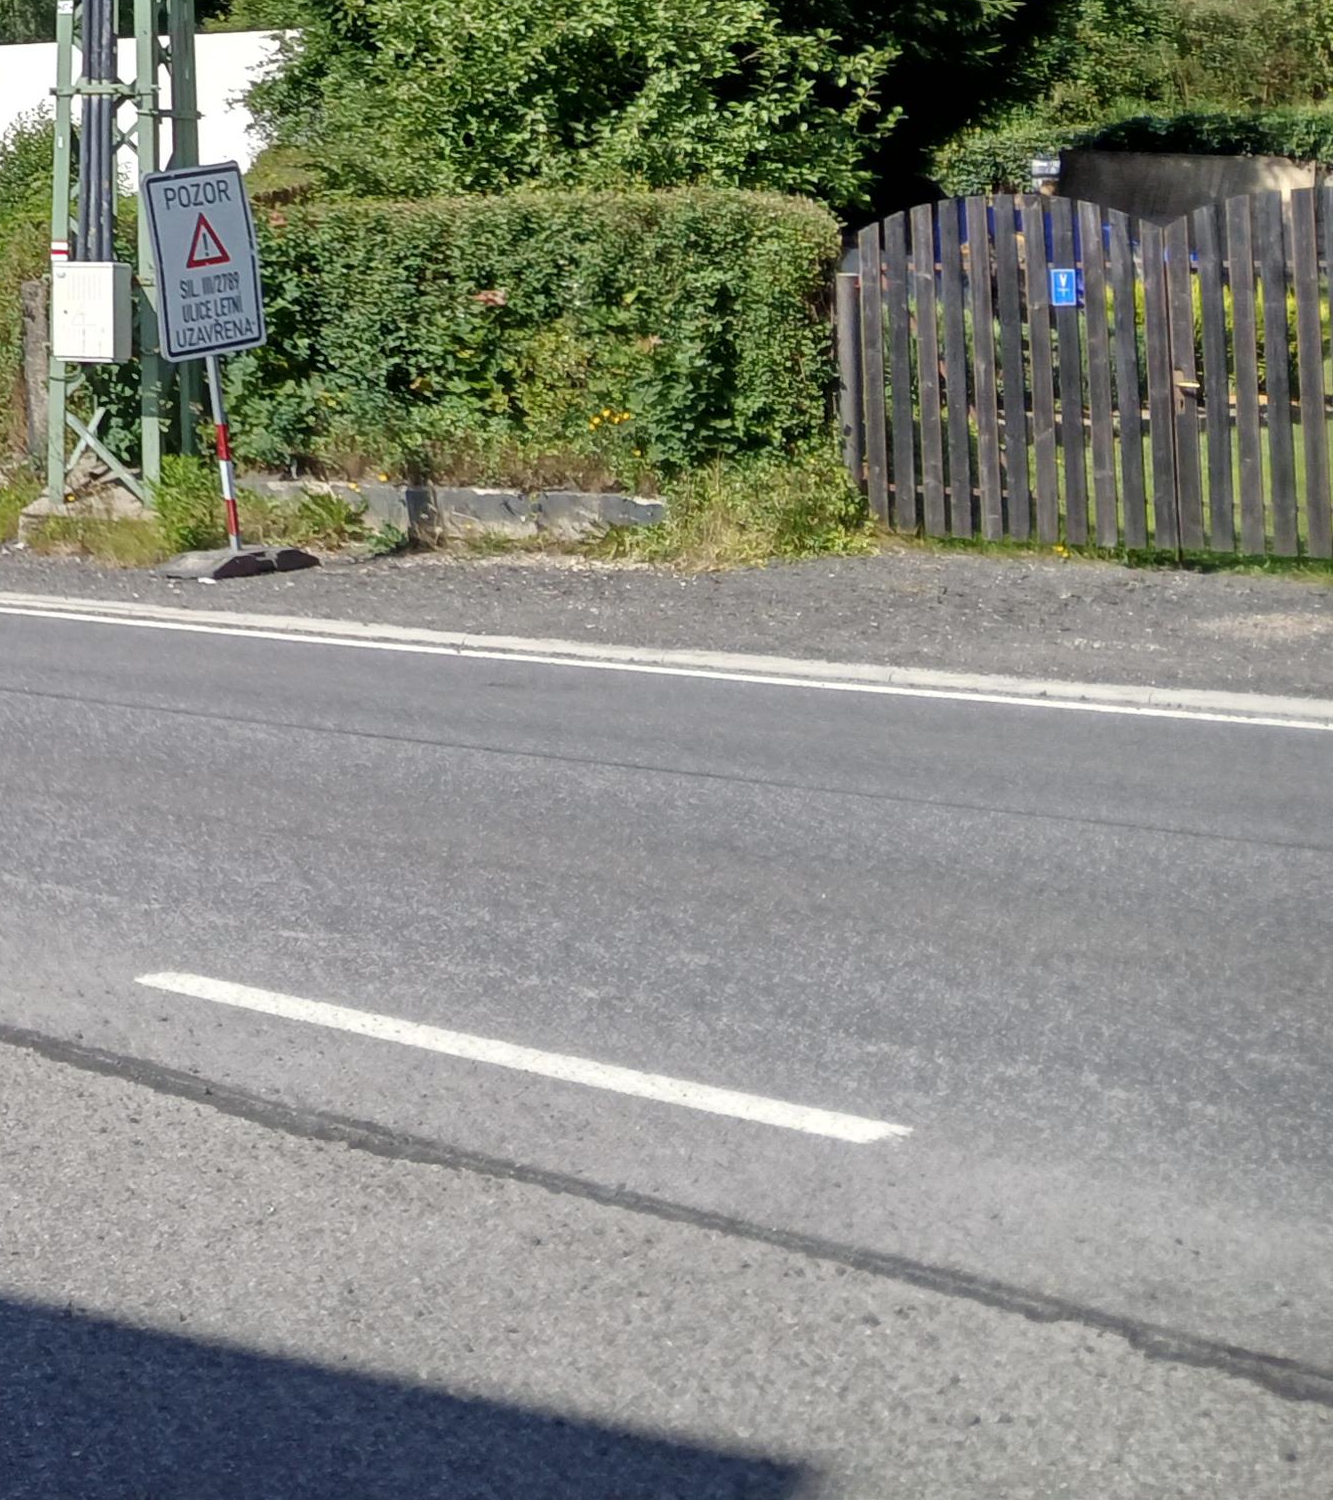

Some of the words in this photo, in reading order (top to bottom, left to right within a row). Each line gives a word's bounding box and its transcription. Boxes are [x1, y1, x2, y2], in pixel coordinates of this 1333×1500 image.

[163, 179, 232, 211] POZOR
[182, 300, 212, 323] ULICE
[176, 317, 253, 348] UZAVŘENA
